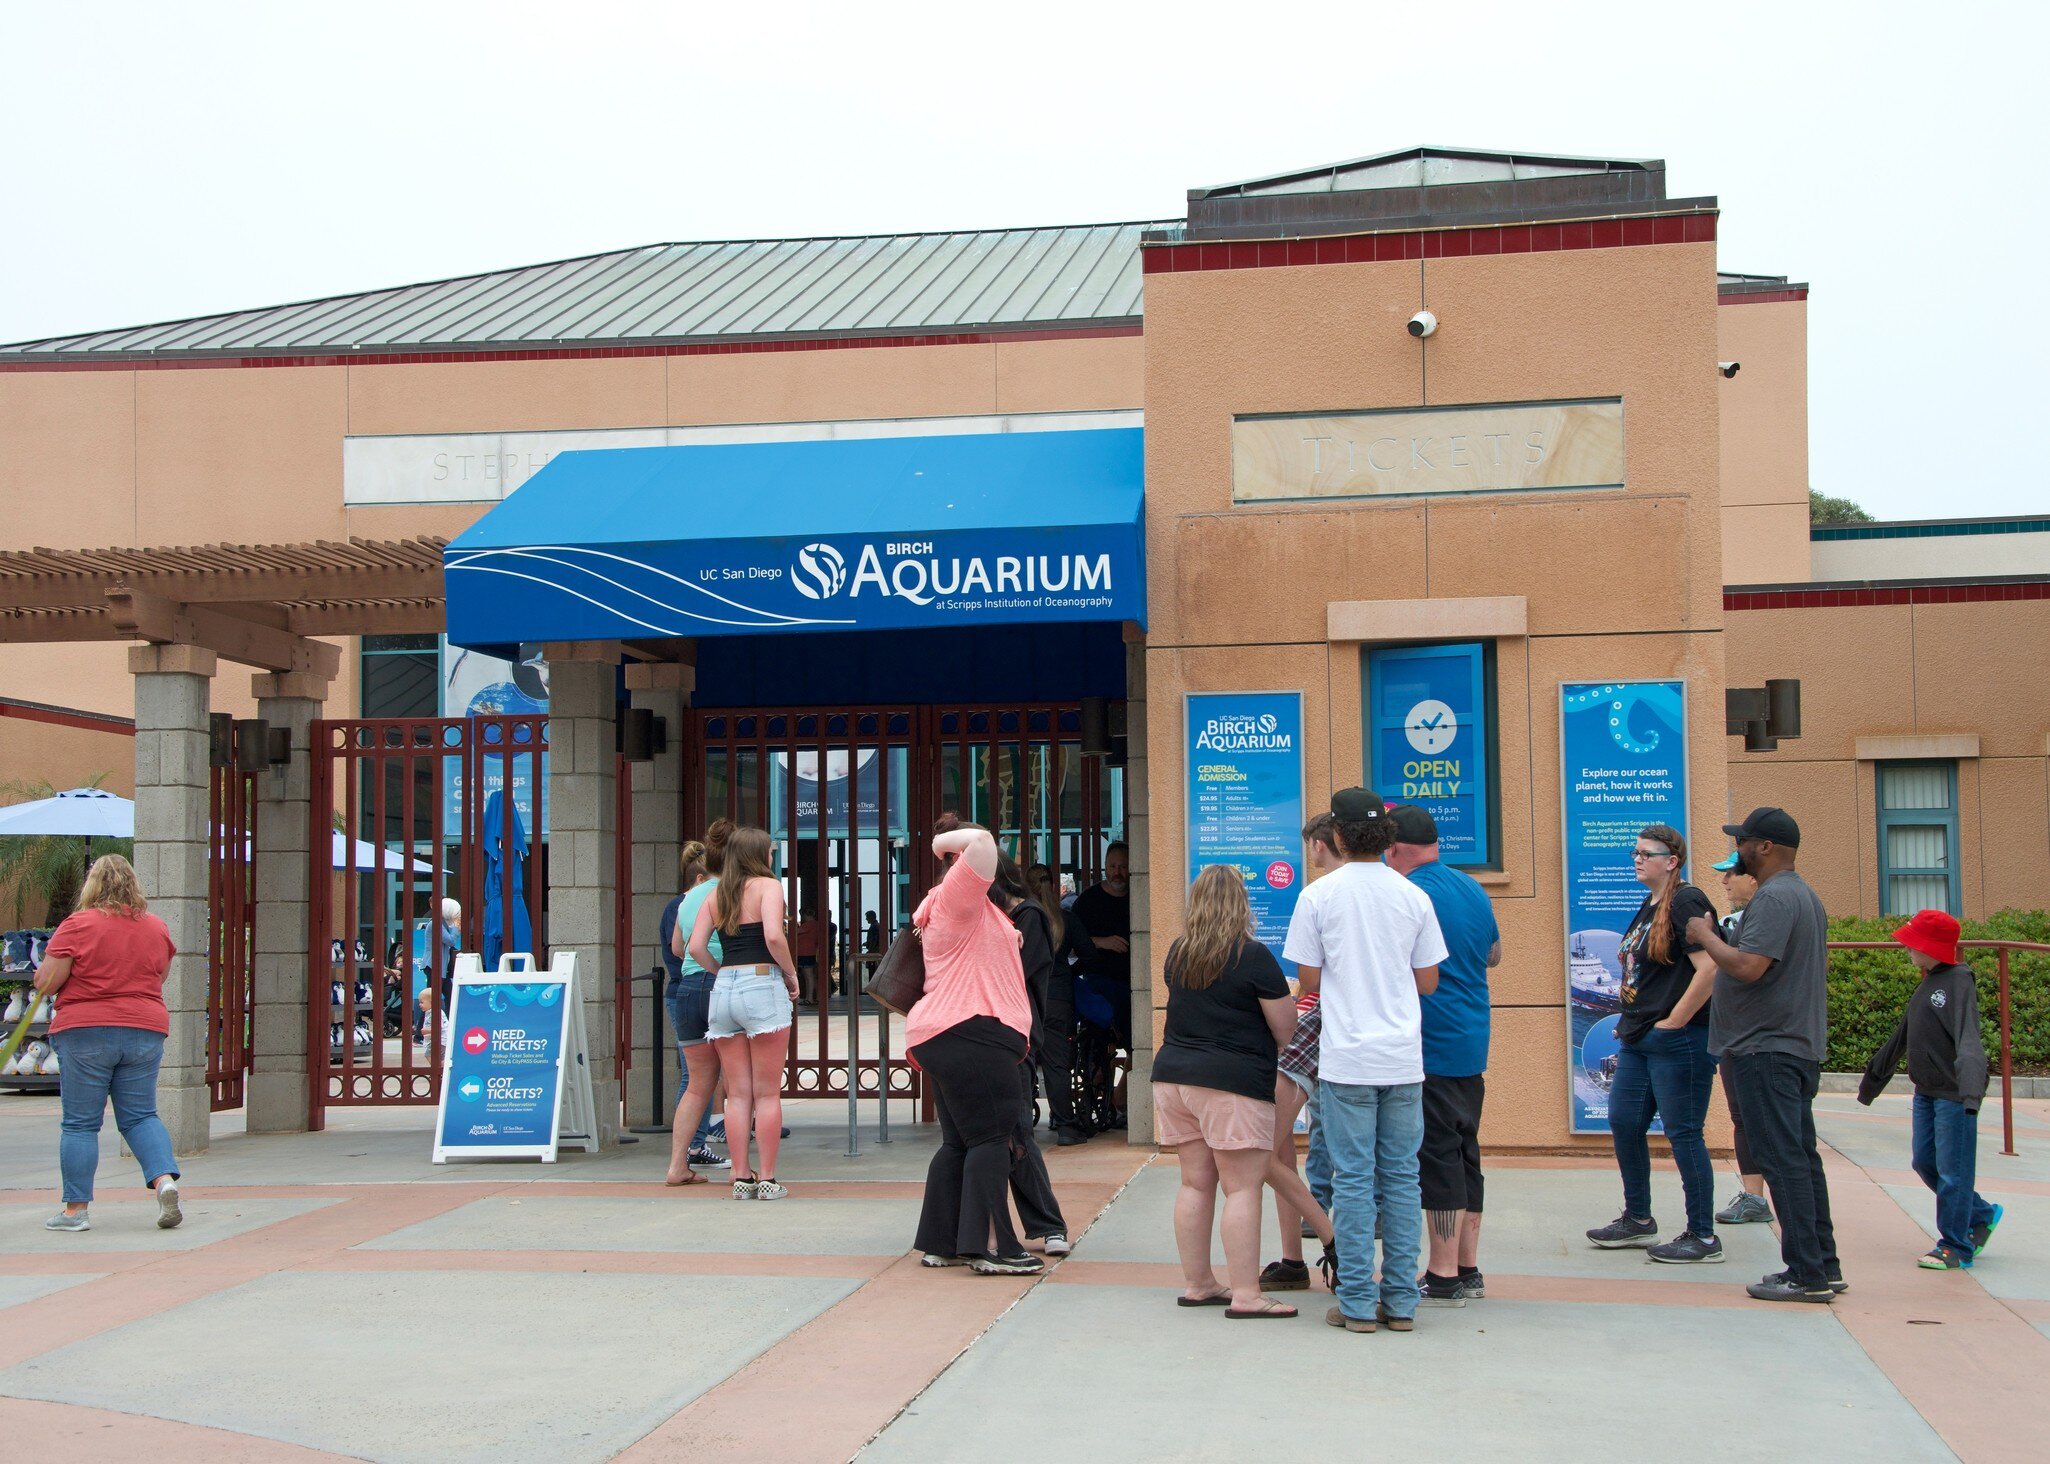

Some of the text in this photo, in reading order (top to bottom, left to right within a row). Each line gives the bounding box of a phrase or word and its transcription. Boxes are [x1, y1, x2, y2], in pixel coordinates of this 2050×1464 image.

[1302, 431, 1546, 473] TICKETS
[886, 542, 933, 555] BIRCH
[700, 567, 782, 580] UC San Diego
[936, 596, 1113, 612] at Scripps Institution of Oceanography
[1207, 720, 1256, 735] BIRCH
[1198, 765, 1238, 773] GENERAL
[1403, 760, 1460, 778] OPEN
[1582, 768, 1618, 779] Explore
[488, 776, 526, 787] thigs
[1198, 774, 1247, 782] ADMISSION
[1403, 781, 1461, 799] DAILY
[1575, 780, 1673, 792] planet, how it works
[1583, 794, 1601, 802] and
[1604, 794, 1624, 802] how
[1643, 793, 1654, 802] fit
[1656, 793, 1668, 802] in.
[797, 808, 833, 816] QUARM
[1444, 807, 1460, 815] p.m.
[1271, 869, 1289, 877] TODAY
[492, 1030, 526, 1040] NEED
[492, 1039, 548, 1051] TICKETS?
[487, 1078, 514, 1088] GOT
[487, 1087, 543, 1099] TICKETS?
